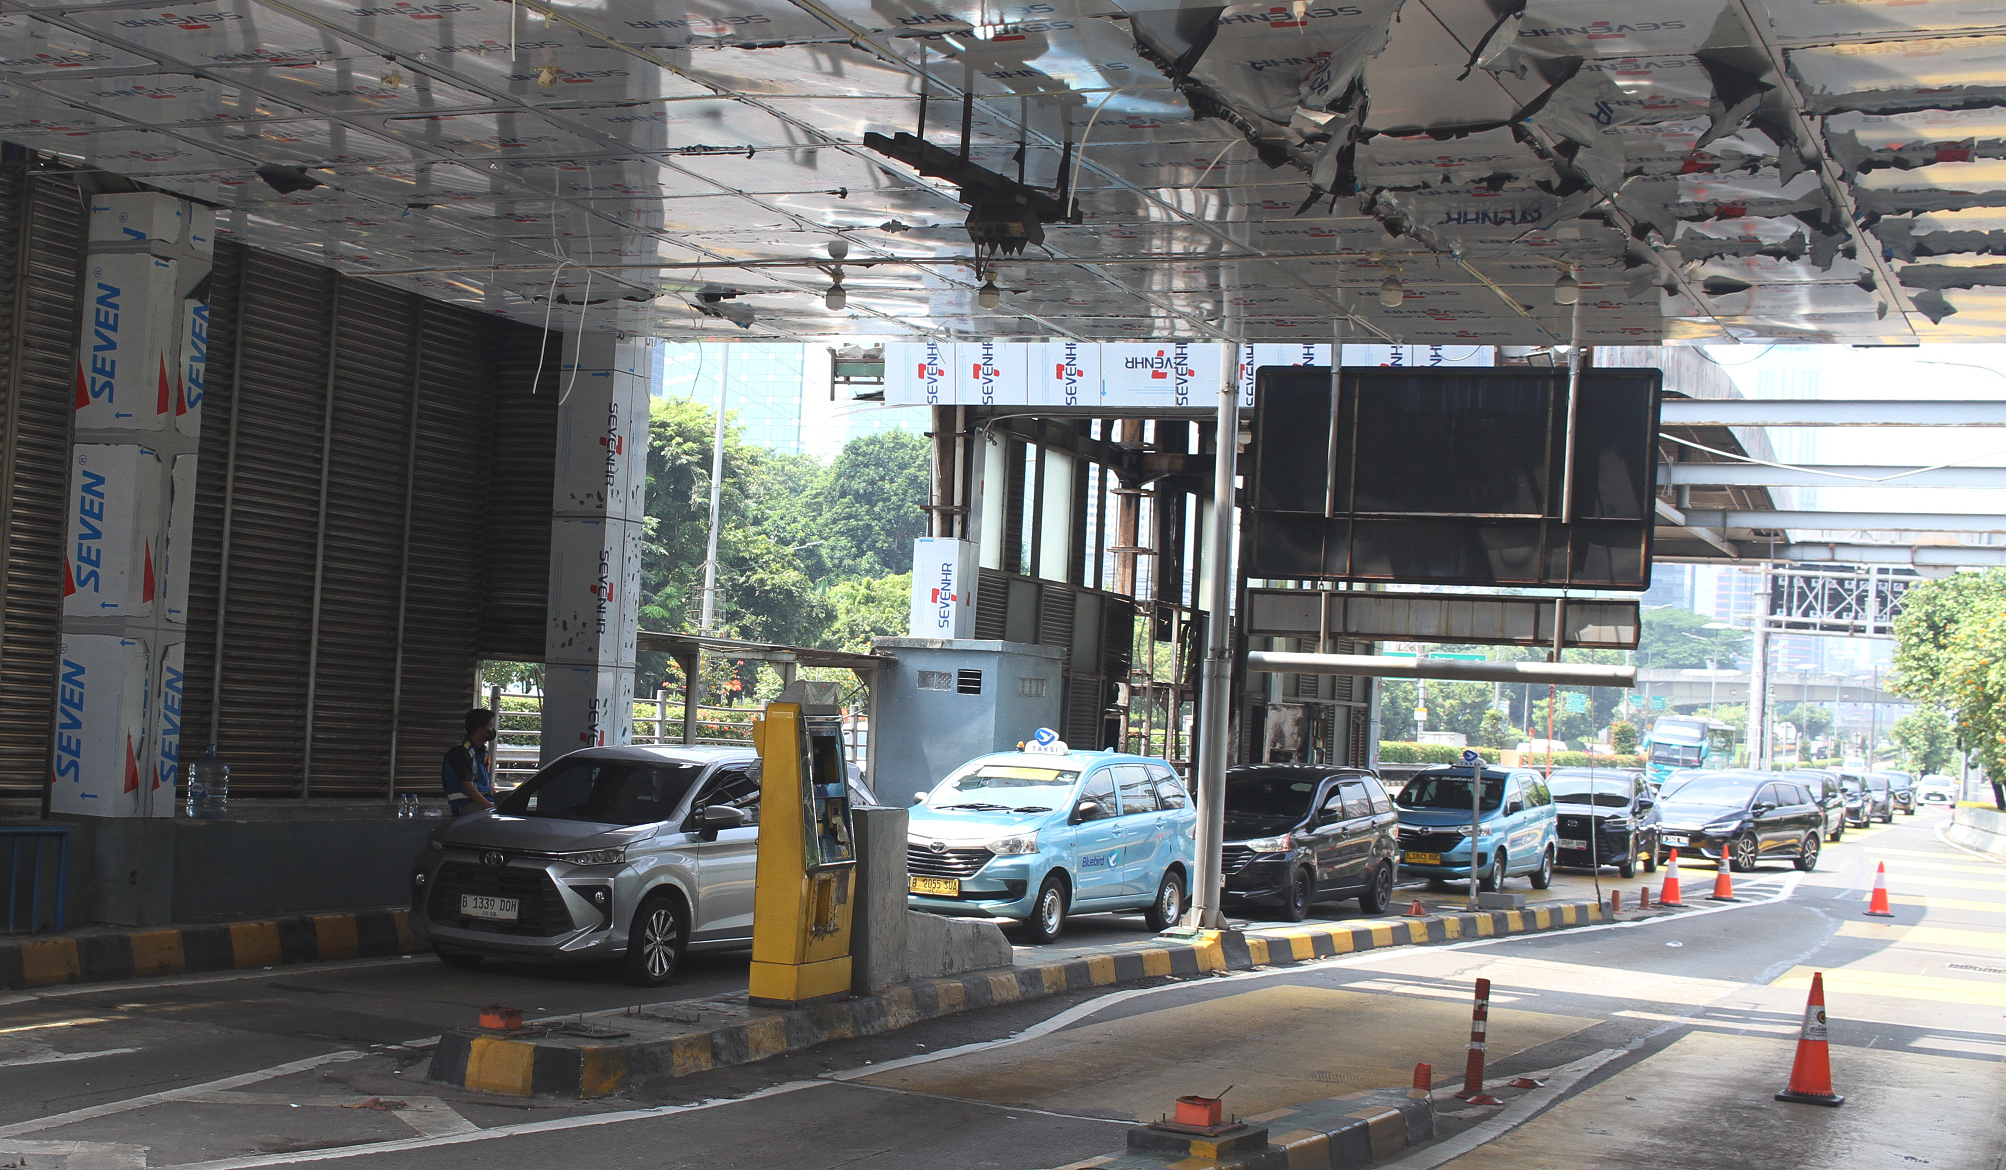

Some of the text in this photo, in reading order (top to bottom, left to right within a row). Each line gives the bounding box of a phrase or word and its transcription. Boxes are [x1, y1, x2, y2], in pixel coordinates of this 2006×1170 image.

[344, 3, 481, 17] SEVENHR
[113, 12, 243, 28] SEVENHR
[623, 14, 771, 30] SEVENHR
[1518, 21, 1685, 37] SEVENHR
[434, 41, 564, 53] SEVENHR
[91, 281, 120, 403] SEVEN
[605, 402, 619, 487] SEVENHR
[76, 470, 105, 593] SEVEN
[596, 550, 610, 635] SEVENHR
[938, 562, 953, 629] SEVENHR
[56, 659, 86, 783] SEVEN
[1082, 855, 1104, 868] Bluebird
[462, 896, 517, 912] B 1339 DOH
